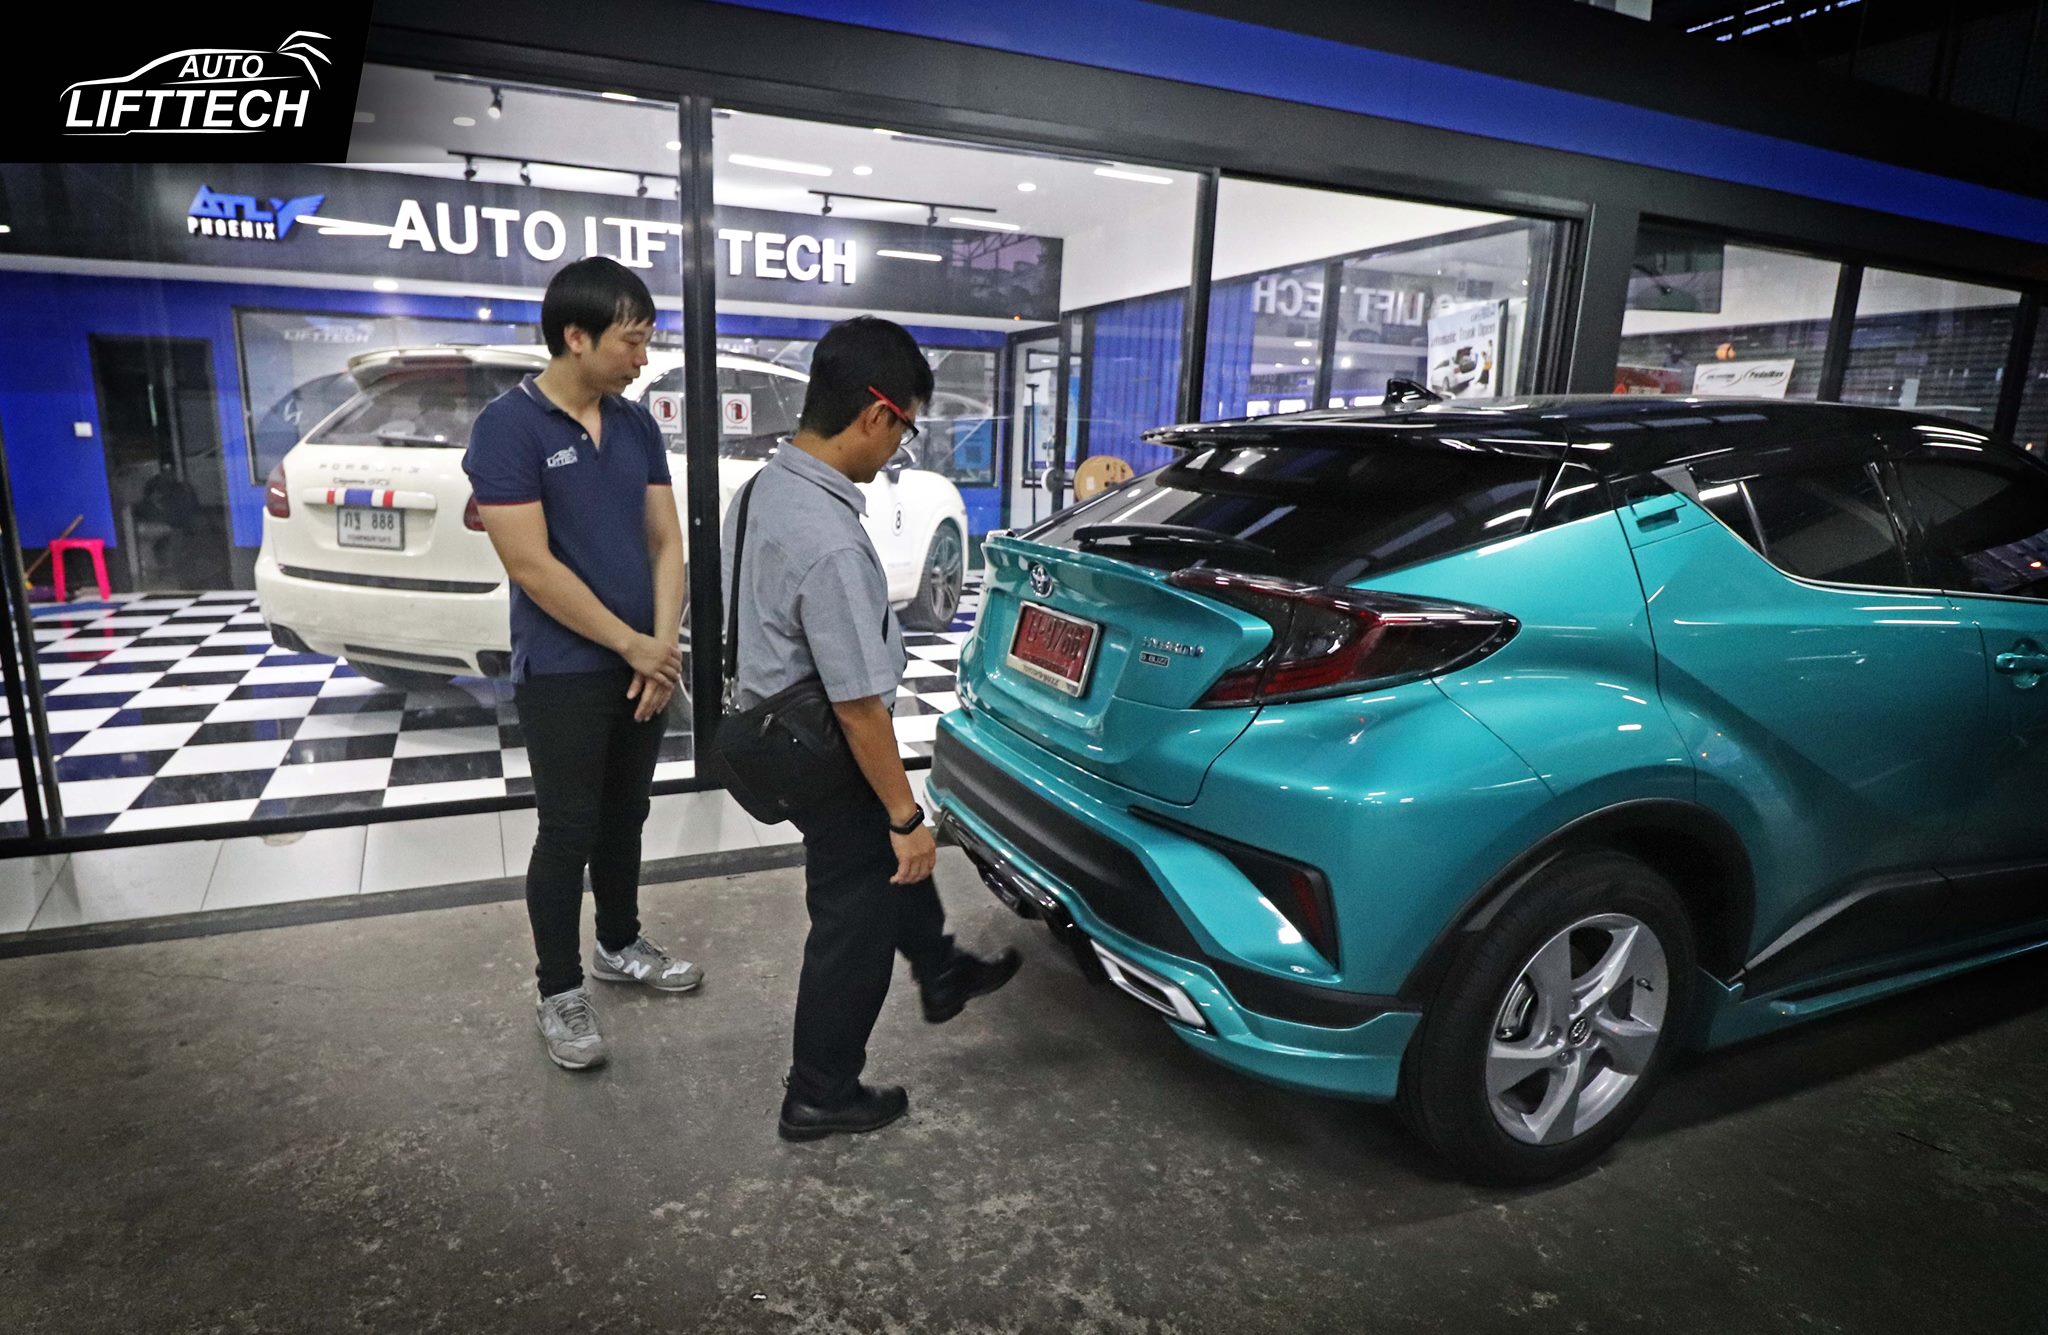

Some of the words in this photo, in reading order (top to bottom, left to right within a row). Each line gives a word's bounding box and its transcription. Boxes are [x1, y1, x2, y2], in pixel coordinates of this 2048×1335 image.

[187, 216, 276, 240] PHOENIX
[388, 199, 567, 261] AUTO
[584, 216, 683, 268] LIF
[718, 228, 858, 284] TECH
[371, 513, 395, 530] 888
[896, 510, 901, 529] 8
[623, 960, 652, 980] N
